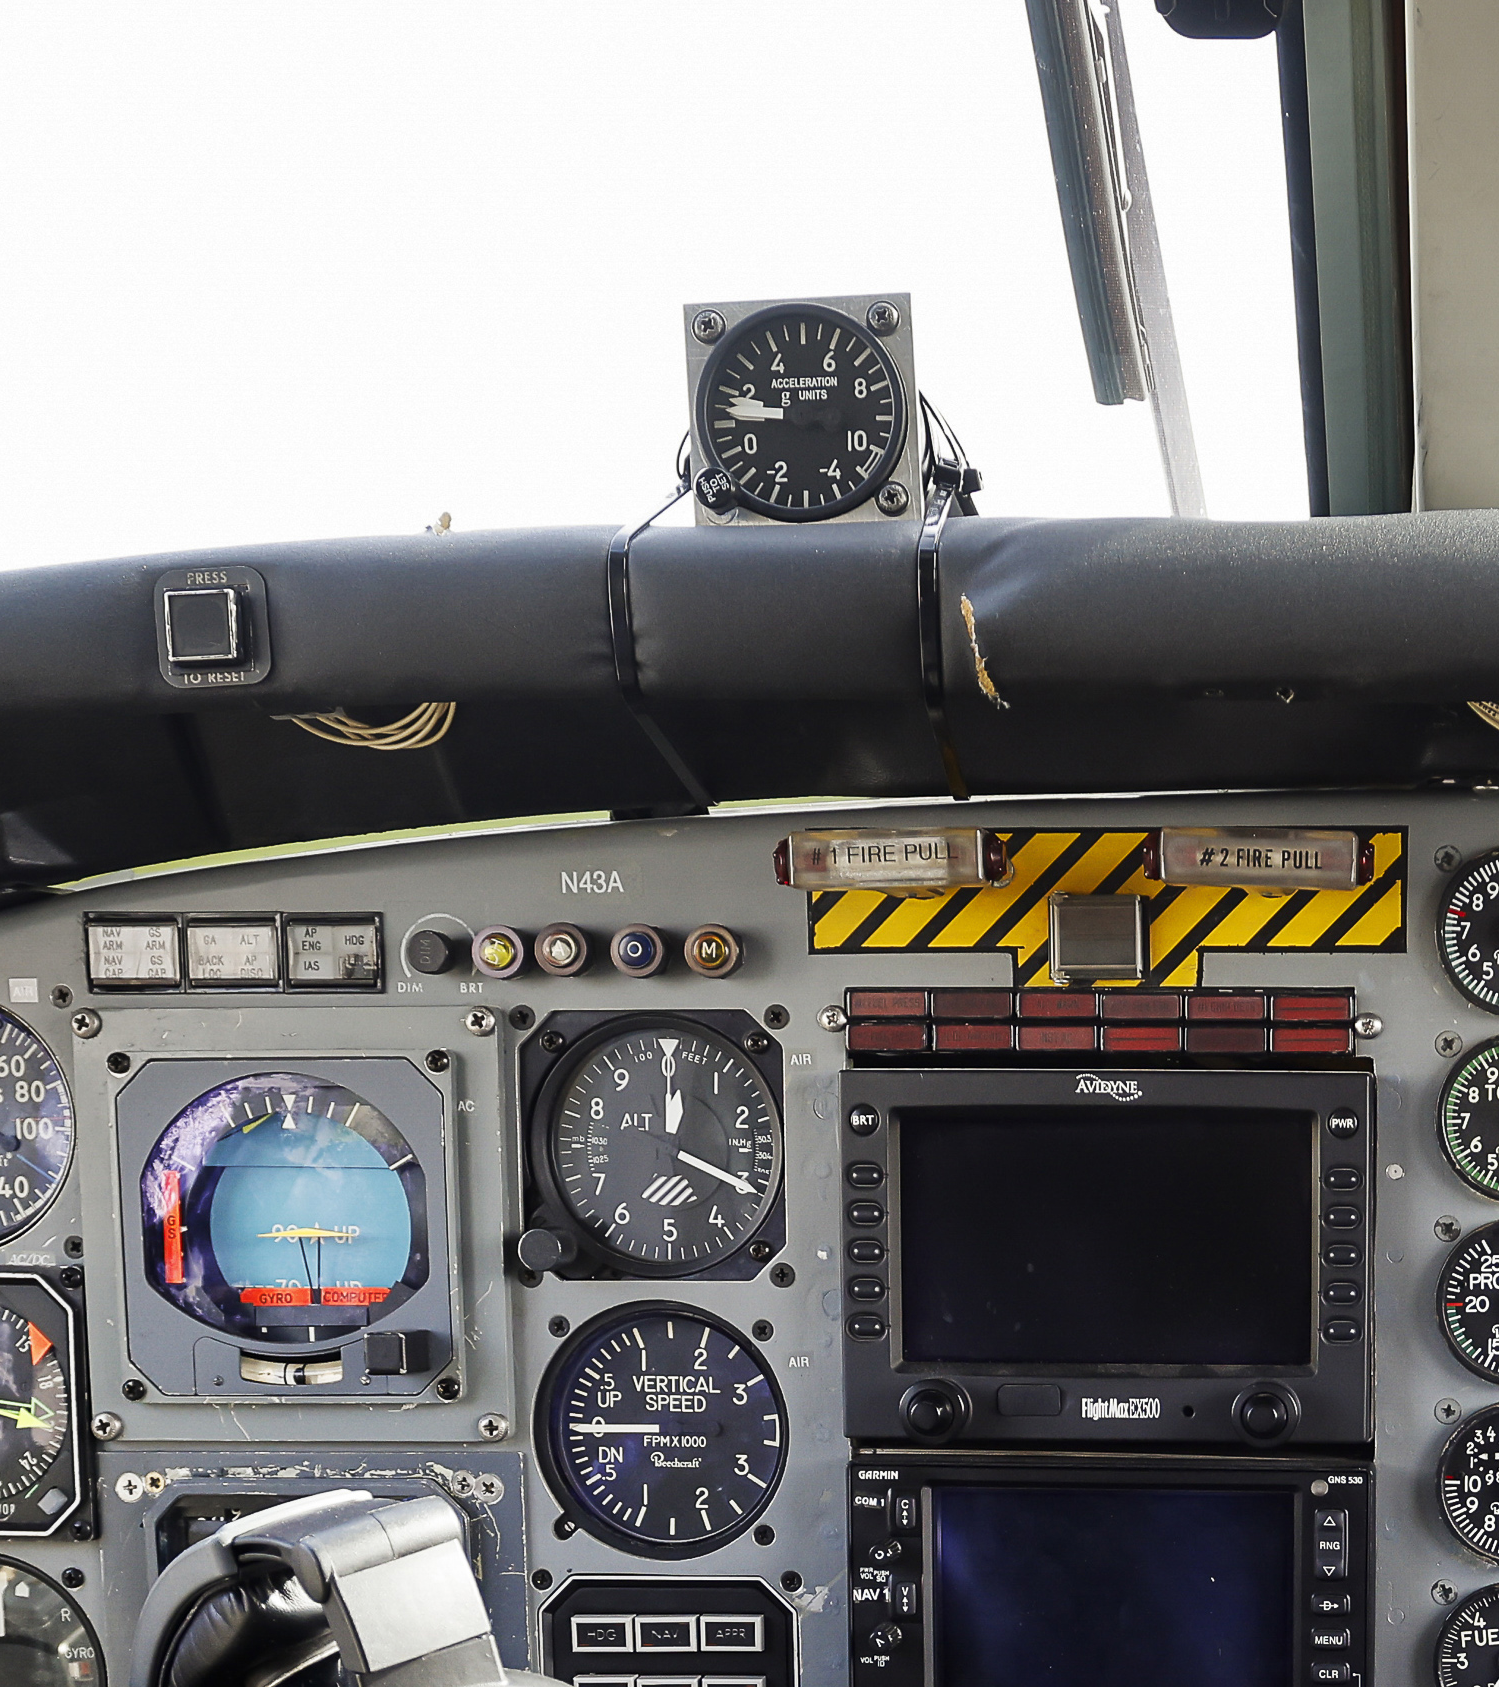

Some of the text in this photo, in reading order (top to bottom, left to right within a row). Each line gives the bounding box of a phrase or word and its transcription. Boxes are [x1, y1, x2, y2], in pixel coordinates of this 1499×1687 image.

[771, 377, 837, 388] ACCELERATION
[781, 390, 827, 406] g UNITS
[847, 431, 867, 451] 10
[187, 571, 227, 584] PRESS
[847, 843, 958, 864] FIRE PULL
[1236, 850, 1322, 869] FIRE PULL
[561, 871, 624, 893] N43A
[302, 941, 321, 951] ENG
[345, 936, 364, 946] HDG
[303, 961, 319, 971] IAS
[398, 982, 423, 994] DIM
[791, 1054, 812, 1065] AIR
[1076, 1077, 1139, 1096] AVIDYNE
[851, 1114, 875, 1127] BRT
[1330, 1117, 1356, 1129] PWR
[15, 1119, 52, 1139] 100
[632, 1375, 721, 1393] VERTICAL
[598, 1392, 622, 1408] UP
[645, 1395, 707, 1412] SPEED
[598, 1447, 624, 1463] DN
[858, 1470, 899, 1480] GARMIN
[1328, 1475, 1363, 1485] GNS 530
[855, 1496, 878, 1508] COM
[1319, 1541, 1341, 1551] RNG
[1314, 1634, 1343, 1646] MENU
[1318, 1669, 1339, 1679] CLR
